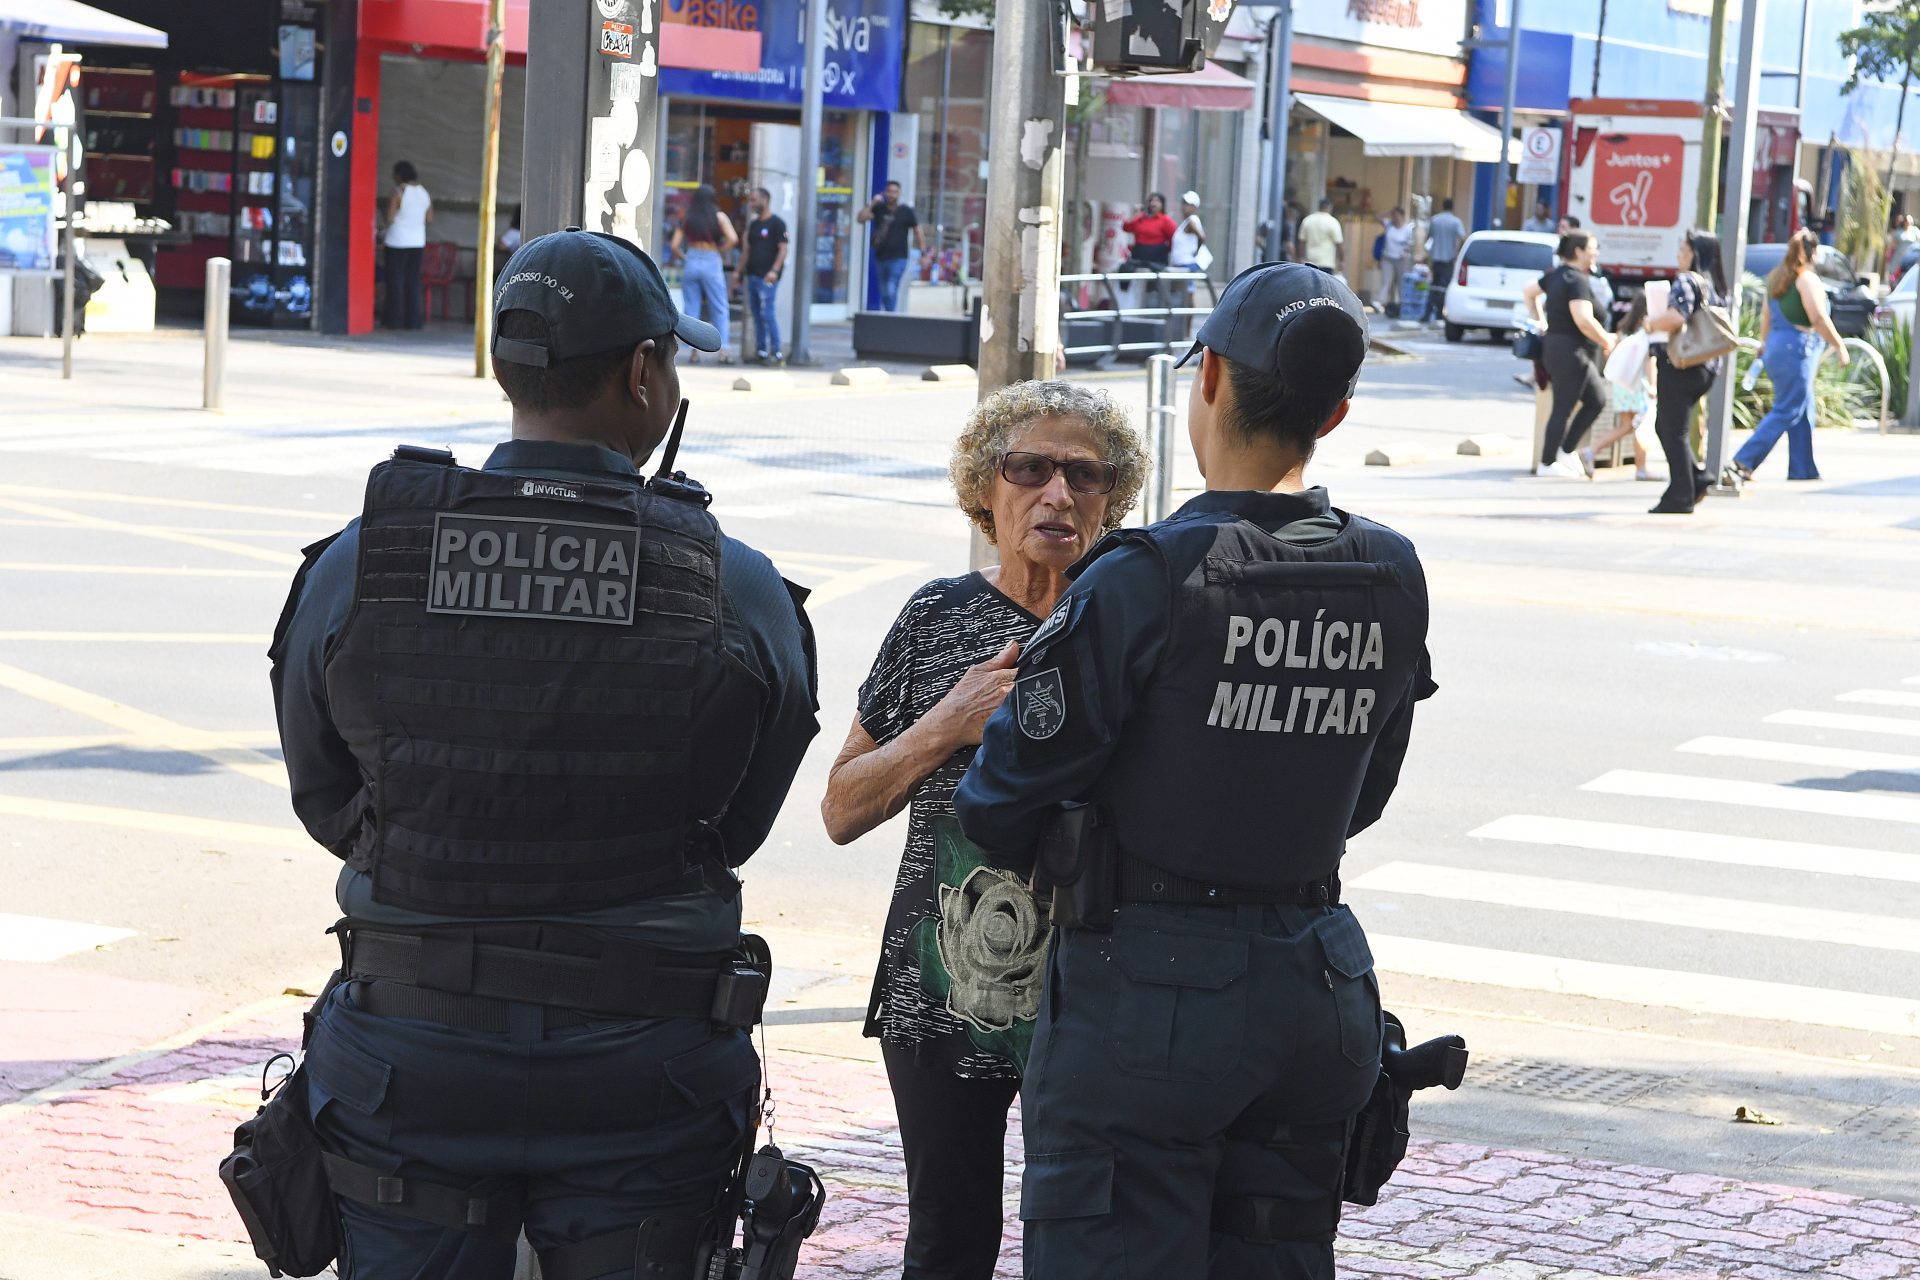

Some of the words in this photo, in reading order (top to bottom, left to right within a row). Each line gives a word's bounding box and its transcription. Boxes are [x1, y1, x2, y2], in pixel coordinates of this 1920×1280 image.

[510, 272, 541, 285] GROSSO
[542, 275, 558, 288] DO
[558, 286, 575, 304] SUL
[1275, 300, 1306, 322] MATO
[534, 484, 577, 498] INVICTUS
[438, 525, 630, 576] POLÍCIA
[433, 570, 627, 617] MILITAR
[1223, 608, 1384, 670] POLÍCIA
[1206, 680, 1376, 735] MILITAR
